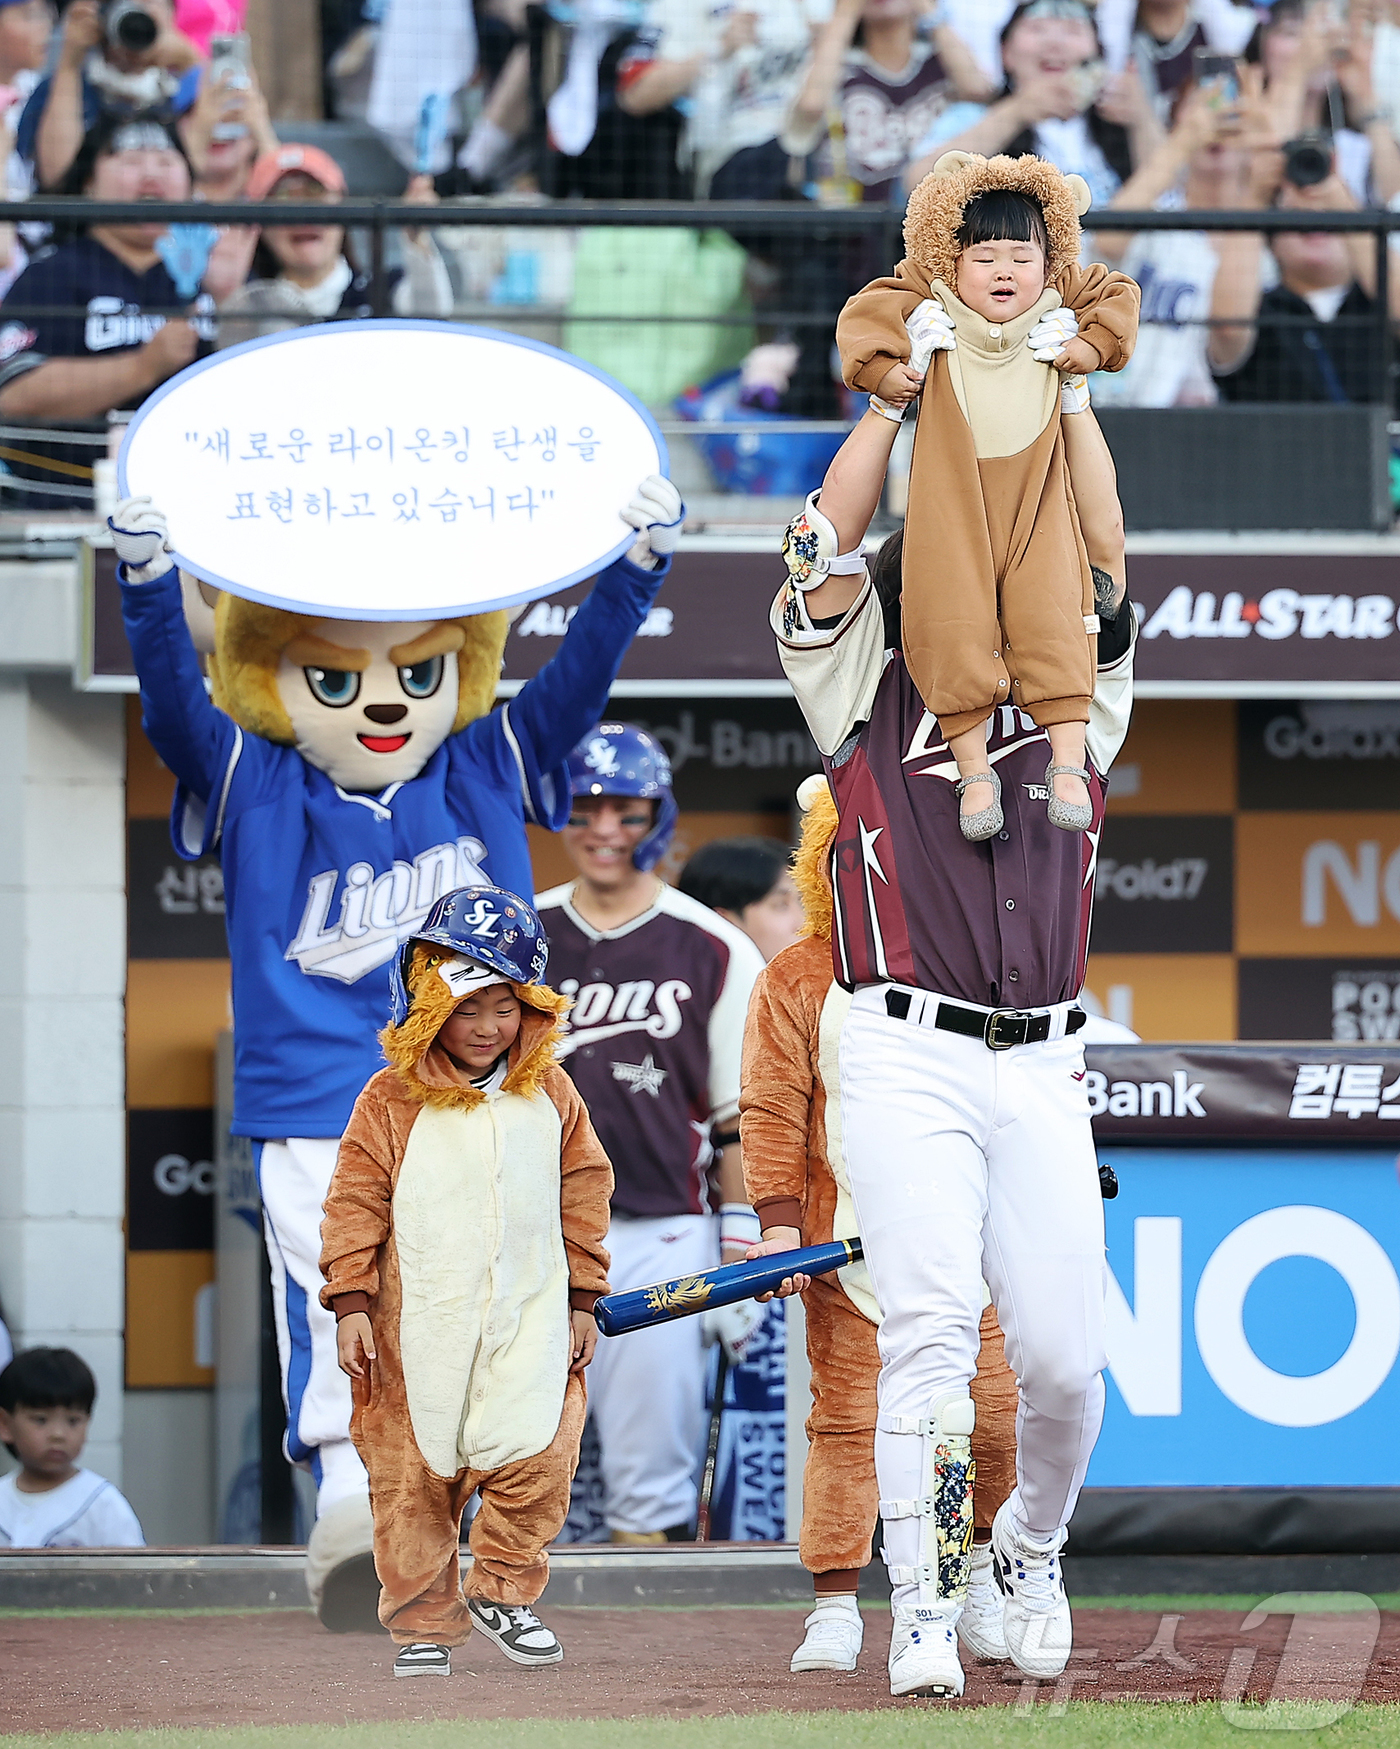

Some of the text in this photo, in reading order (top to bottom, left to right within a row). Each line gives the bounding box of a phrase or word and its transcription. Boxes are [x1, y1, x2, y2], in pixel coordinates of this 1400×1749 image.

[185, 426, 602, 463] "새로운 라이온킹 탄생을
[226, 486, 555, 524] 표현하고 있습니다"
